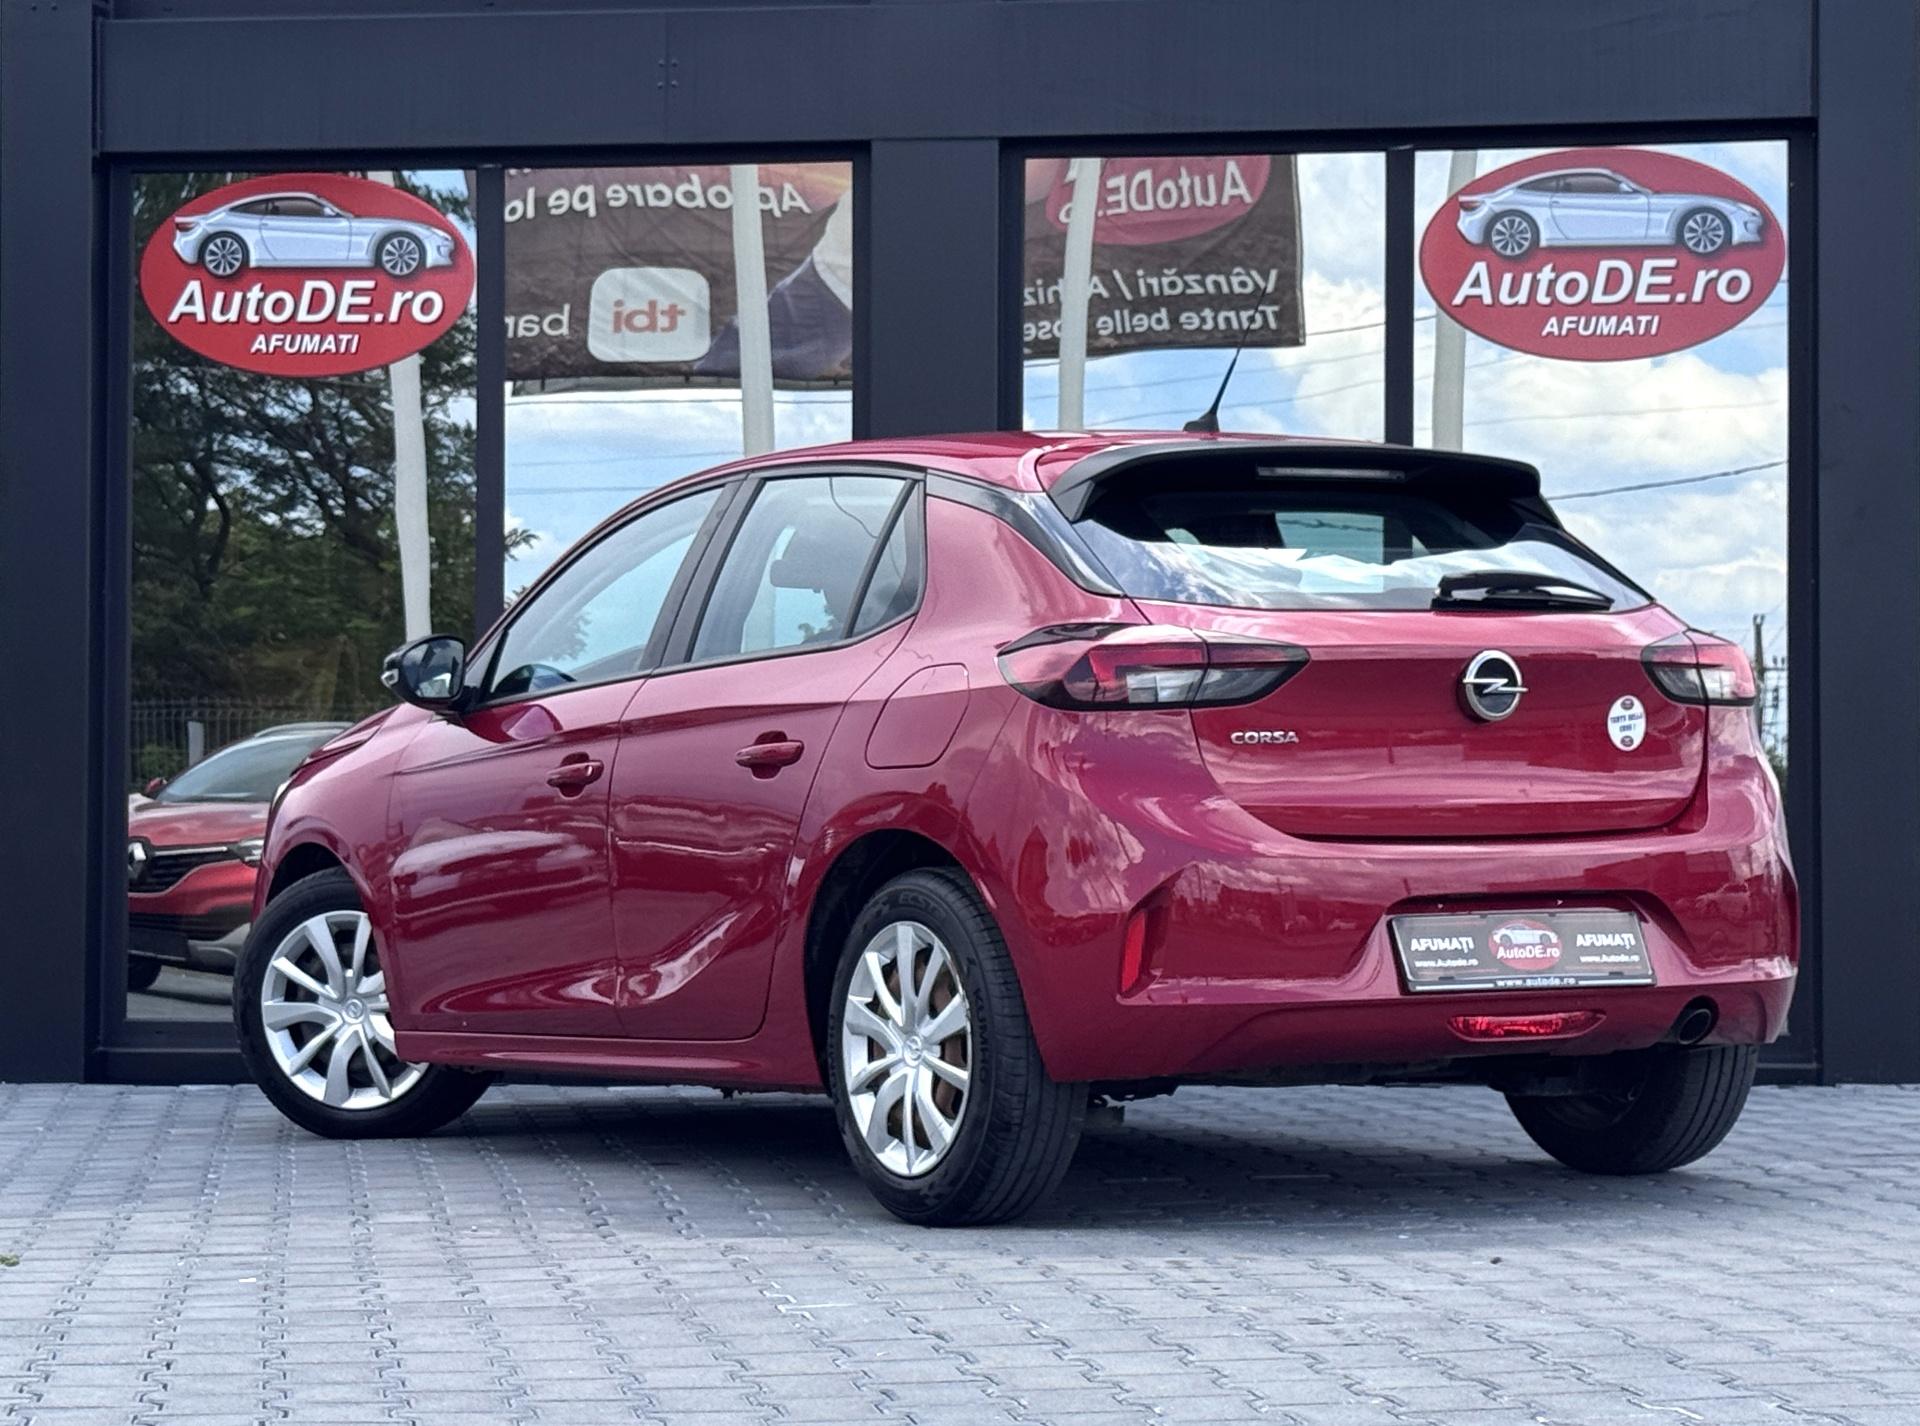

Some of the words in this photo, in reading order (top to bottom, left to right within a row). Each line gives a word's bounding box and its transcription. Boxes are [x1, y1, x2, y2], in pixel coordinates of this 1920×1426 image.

[1452, 258, 1753, 306] AutoDE.ro
[168, 280, 444, 324] AutoDE.ro
[1541, 315, 1660, 337] AFUMATI
[251, 334, 359, 355] AFUMATI
[1231, 731, 1300, 745] CORSA
[1497, 945, 1560, 959] AutoDE.ro
[1495, 977, 1576, 987] www.autode.ro
